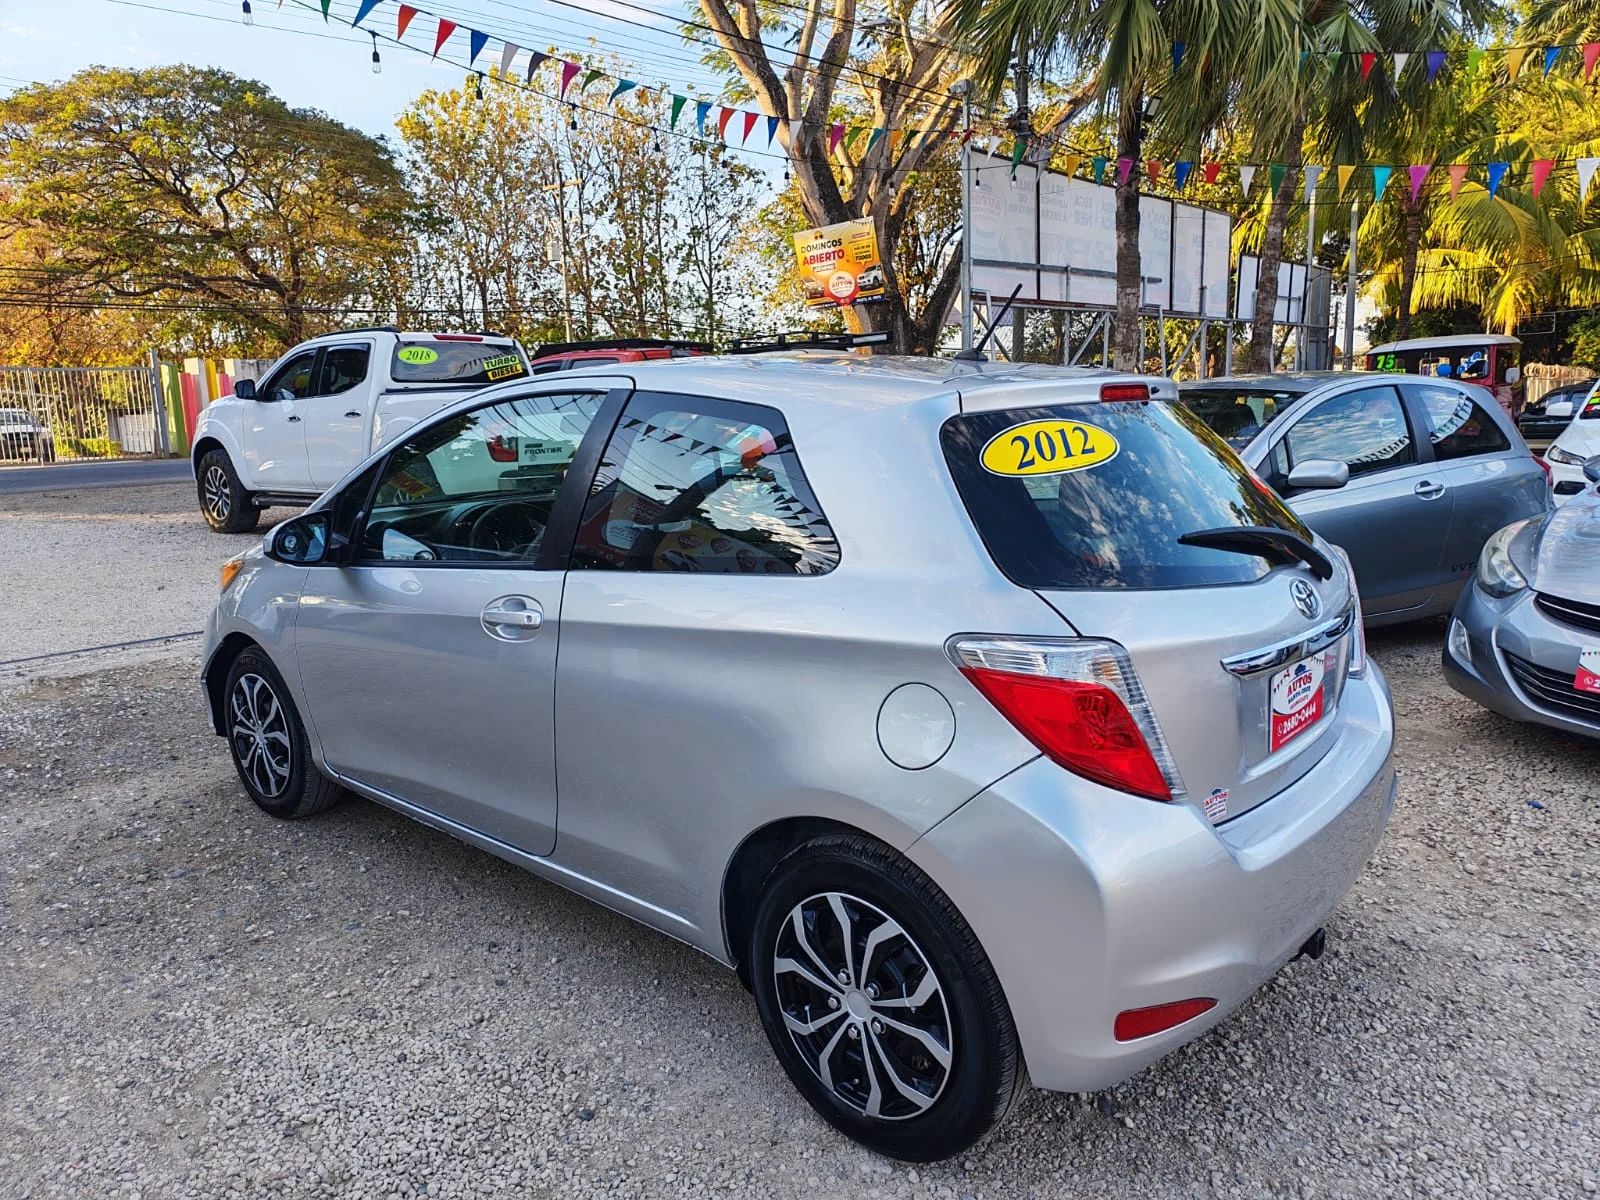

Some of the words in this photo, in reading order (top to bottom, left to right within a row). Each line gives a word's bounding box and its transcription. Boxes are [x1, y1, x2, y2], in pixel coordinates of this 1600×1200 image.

[801, 239, 842, 253] DOMINGOS
[803, 249, 845, 266] ABIERTO
[406, 350, 432, 361] 2018
[485, 356, 517, 368] TURBO
[491, 365, 520, 379] DIESEL
[525, 447, 562, 455] FRONTIER
[1011, 426, 1095, 470] 2012
[1287, 673, 1312, 697] AUTOS
[1283, 701, 1316, 734] 2680-0444
[1205, 792, 1228, 806] AUTOS
